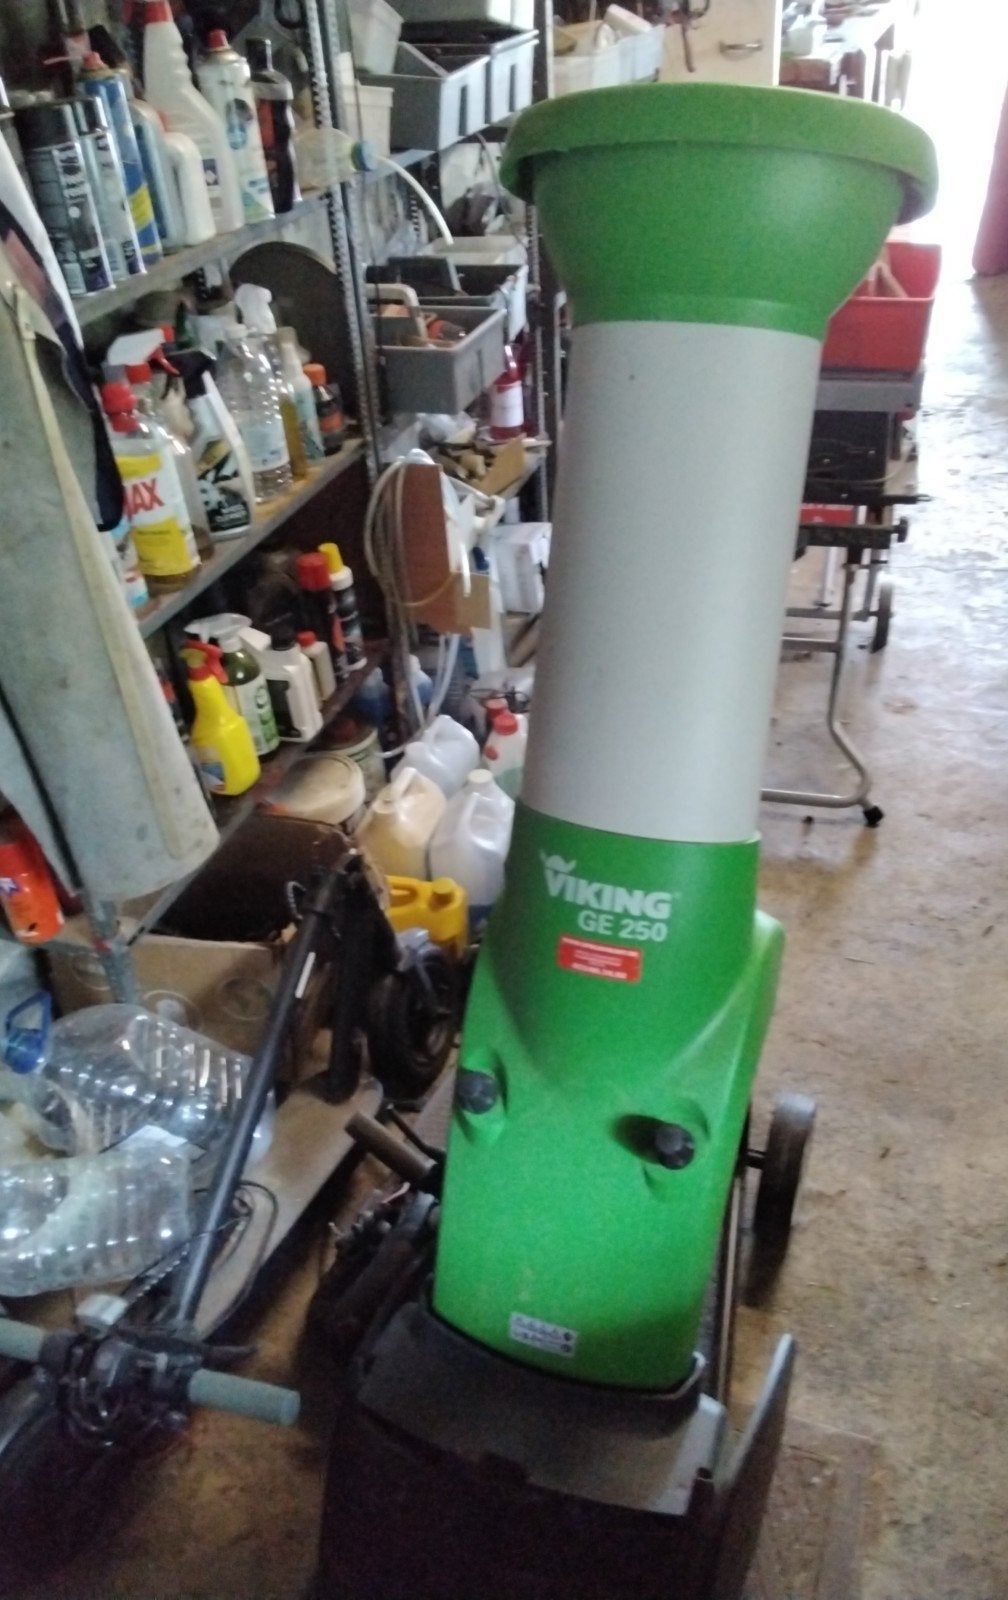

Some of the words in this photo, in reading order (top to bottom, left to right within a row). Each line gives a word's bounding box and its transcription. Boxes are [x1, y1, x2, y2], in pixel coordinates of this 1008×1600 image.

[544, 868, 673, 920] VIKING
[577, 909, 614, 936] GE
[618, 918, 669, 942] 250
